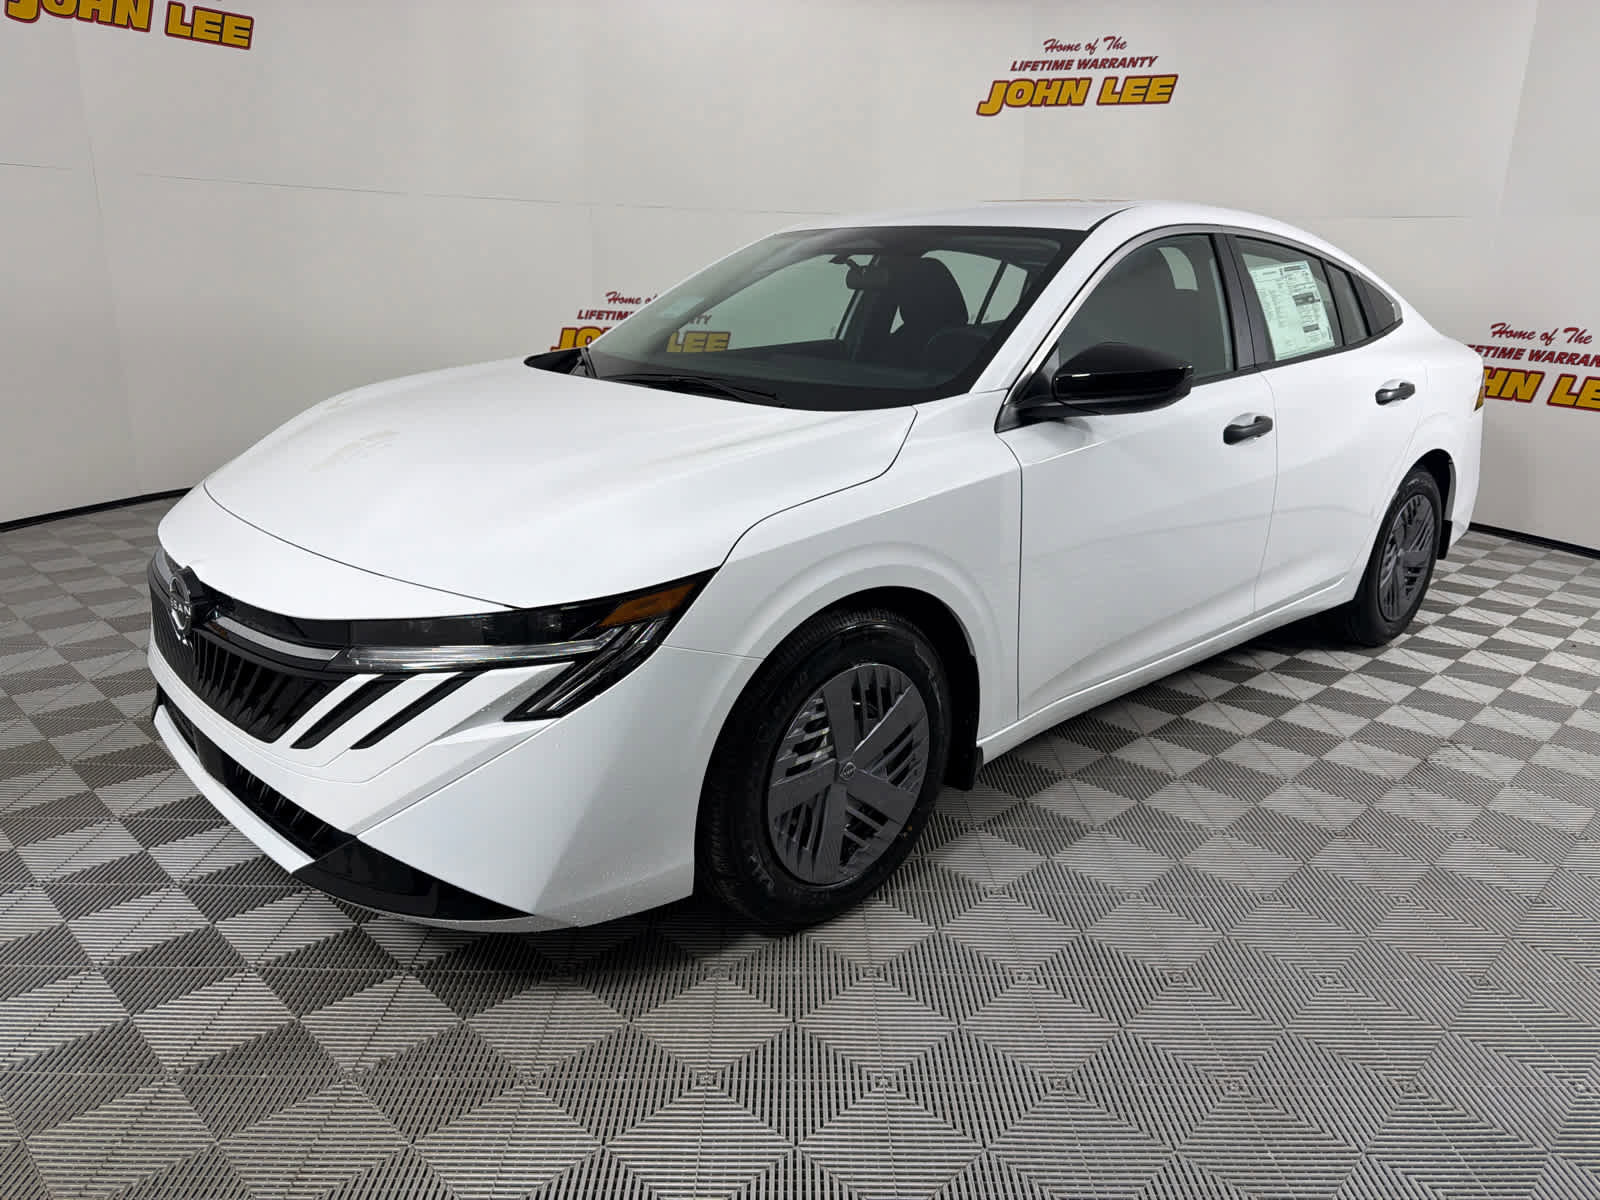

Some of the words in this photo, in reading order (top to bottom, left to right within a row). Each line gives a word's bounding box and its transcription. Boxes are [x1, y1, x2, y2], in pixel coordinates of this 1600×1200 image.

[165, 1, 254, 50] LEE
[1043, 38, 1081, 53] Home
[1084, 38, 1099, 55] of
[1103, 36, 1127, 50] The
[1010, 58, 1074, 72] LIFETIME
[1077, 56, 1158, 70] WARRANTY
[976, 77, 1092, 117] JOHN
[1096, 74, 1179, 106] LEE
[606, 291, 641, 304] Home
[666, 330, 731, 353] LEE
[1490, 322, 1536, 340] Home
[1540, 328, 1558, 346] of
[1563, 327, 1592, 344] The
[1463, 344, 1525, 360] ETIME
[1483, 365, 1545, 403] HN
